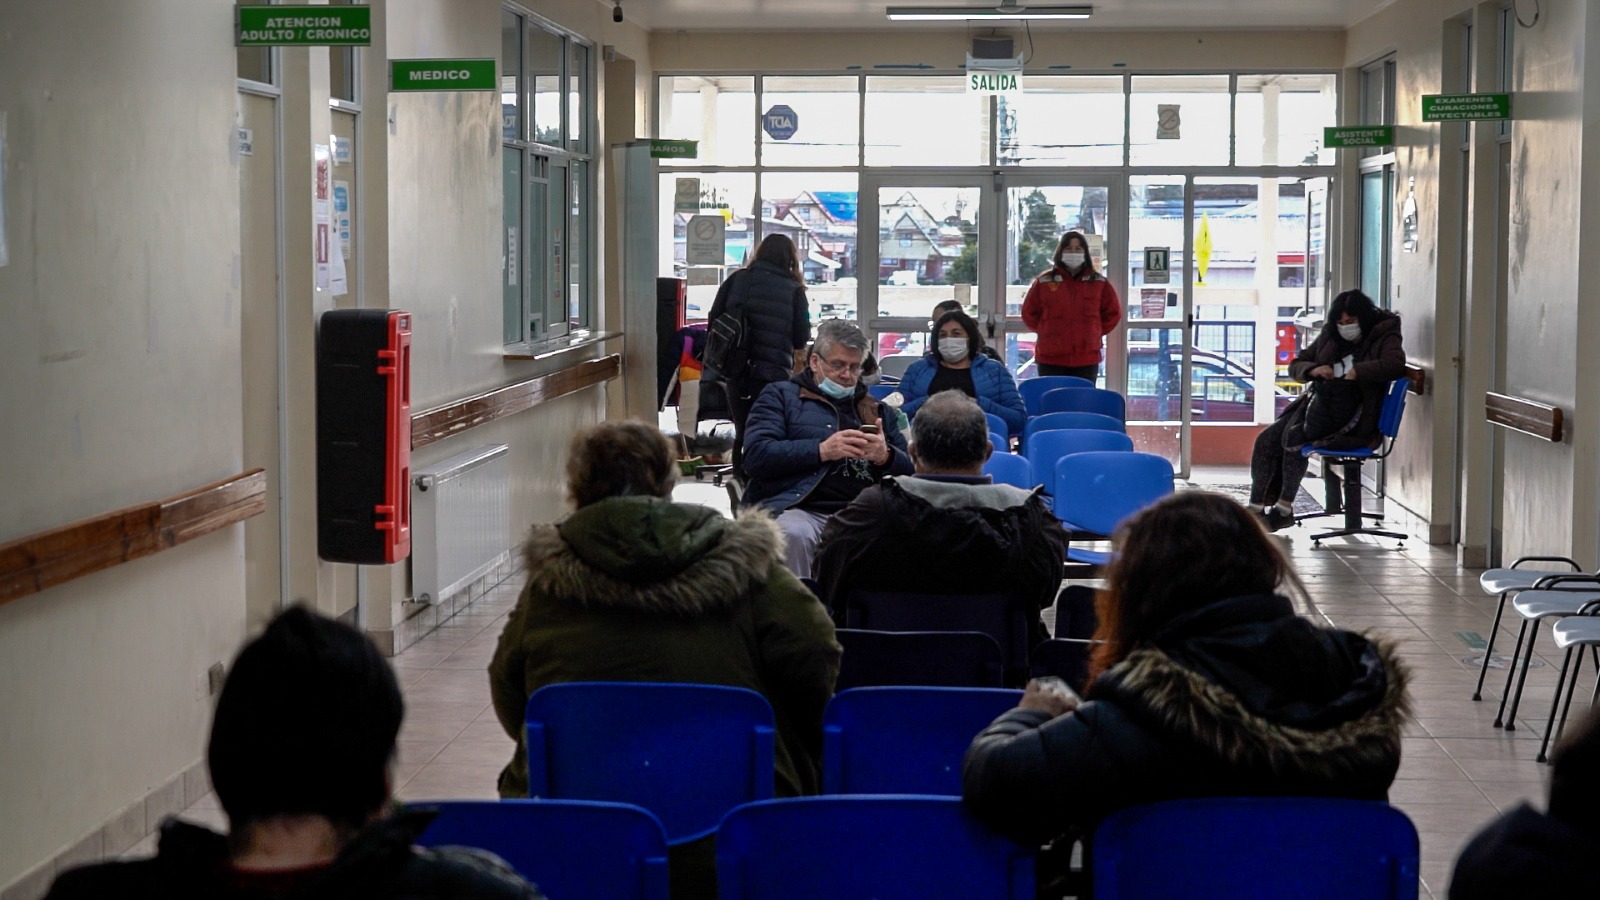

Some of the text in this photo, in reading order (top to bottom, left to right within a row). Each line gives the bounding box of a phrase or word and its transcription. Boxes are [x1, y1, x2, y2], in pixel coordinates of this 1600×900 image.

[265, 17, 341, 28] ATENCION
[240, 29, 294, 41] ADULTO
[306, 28, 370, 40] CRONICO
[409, 70, 470, 81] MEDICO
[971, 74, 1018, 91] SALIDA
[1334, 130, 1385, 138] ASISTENTE
